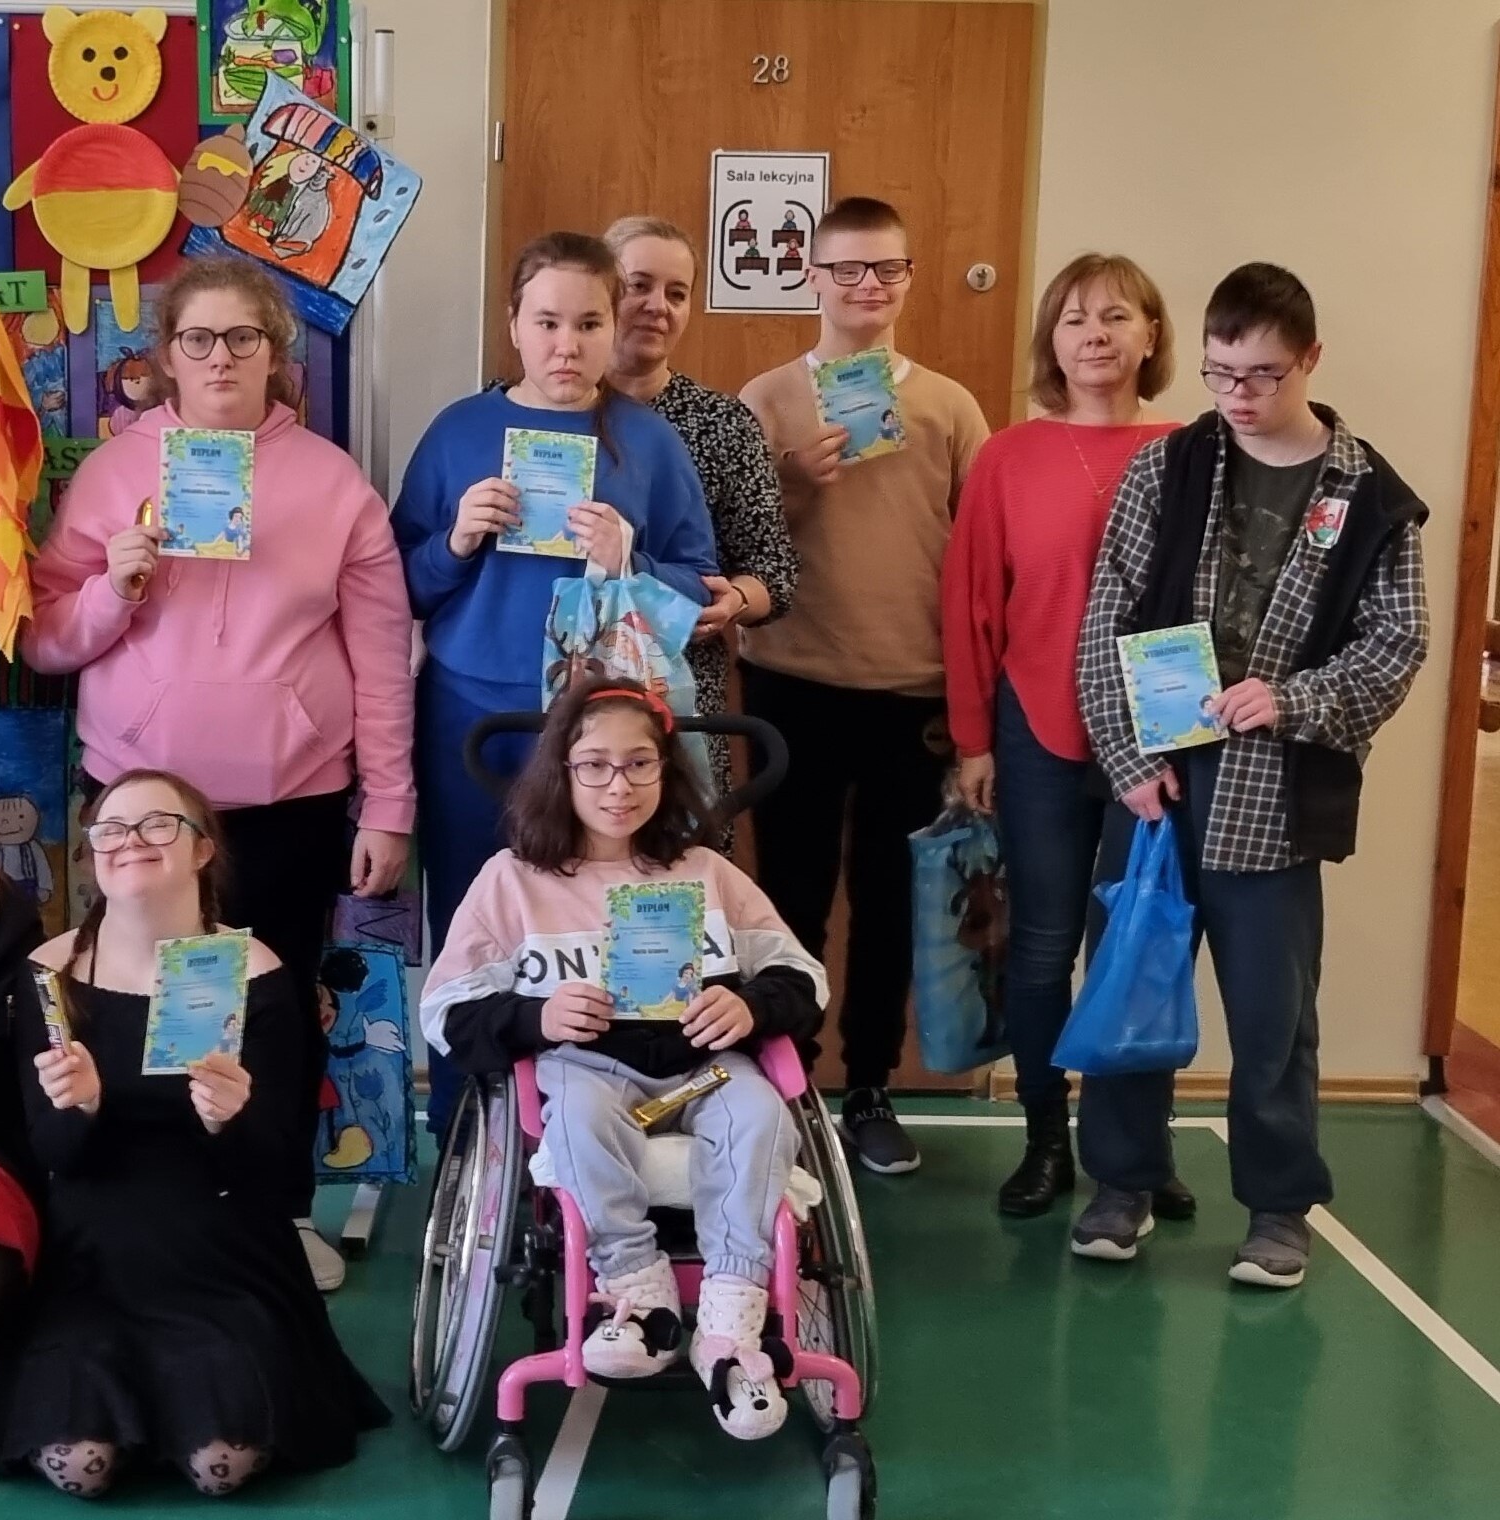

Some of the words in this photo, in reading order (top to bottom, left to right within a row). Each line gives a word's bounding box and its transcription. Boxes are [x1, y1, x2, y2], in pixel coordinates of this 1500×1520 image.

[752, 55, 789, 83] 28
[726, 170, 755, 181] Sala
[759, 171, 814, 185] lekcyjna
[190, 447, 222, 458] DYPLOM
[636, 903, 670, 913] DYPLOM
